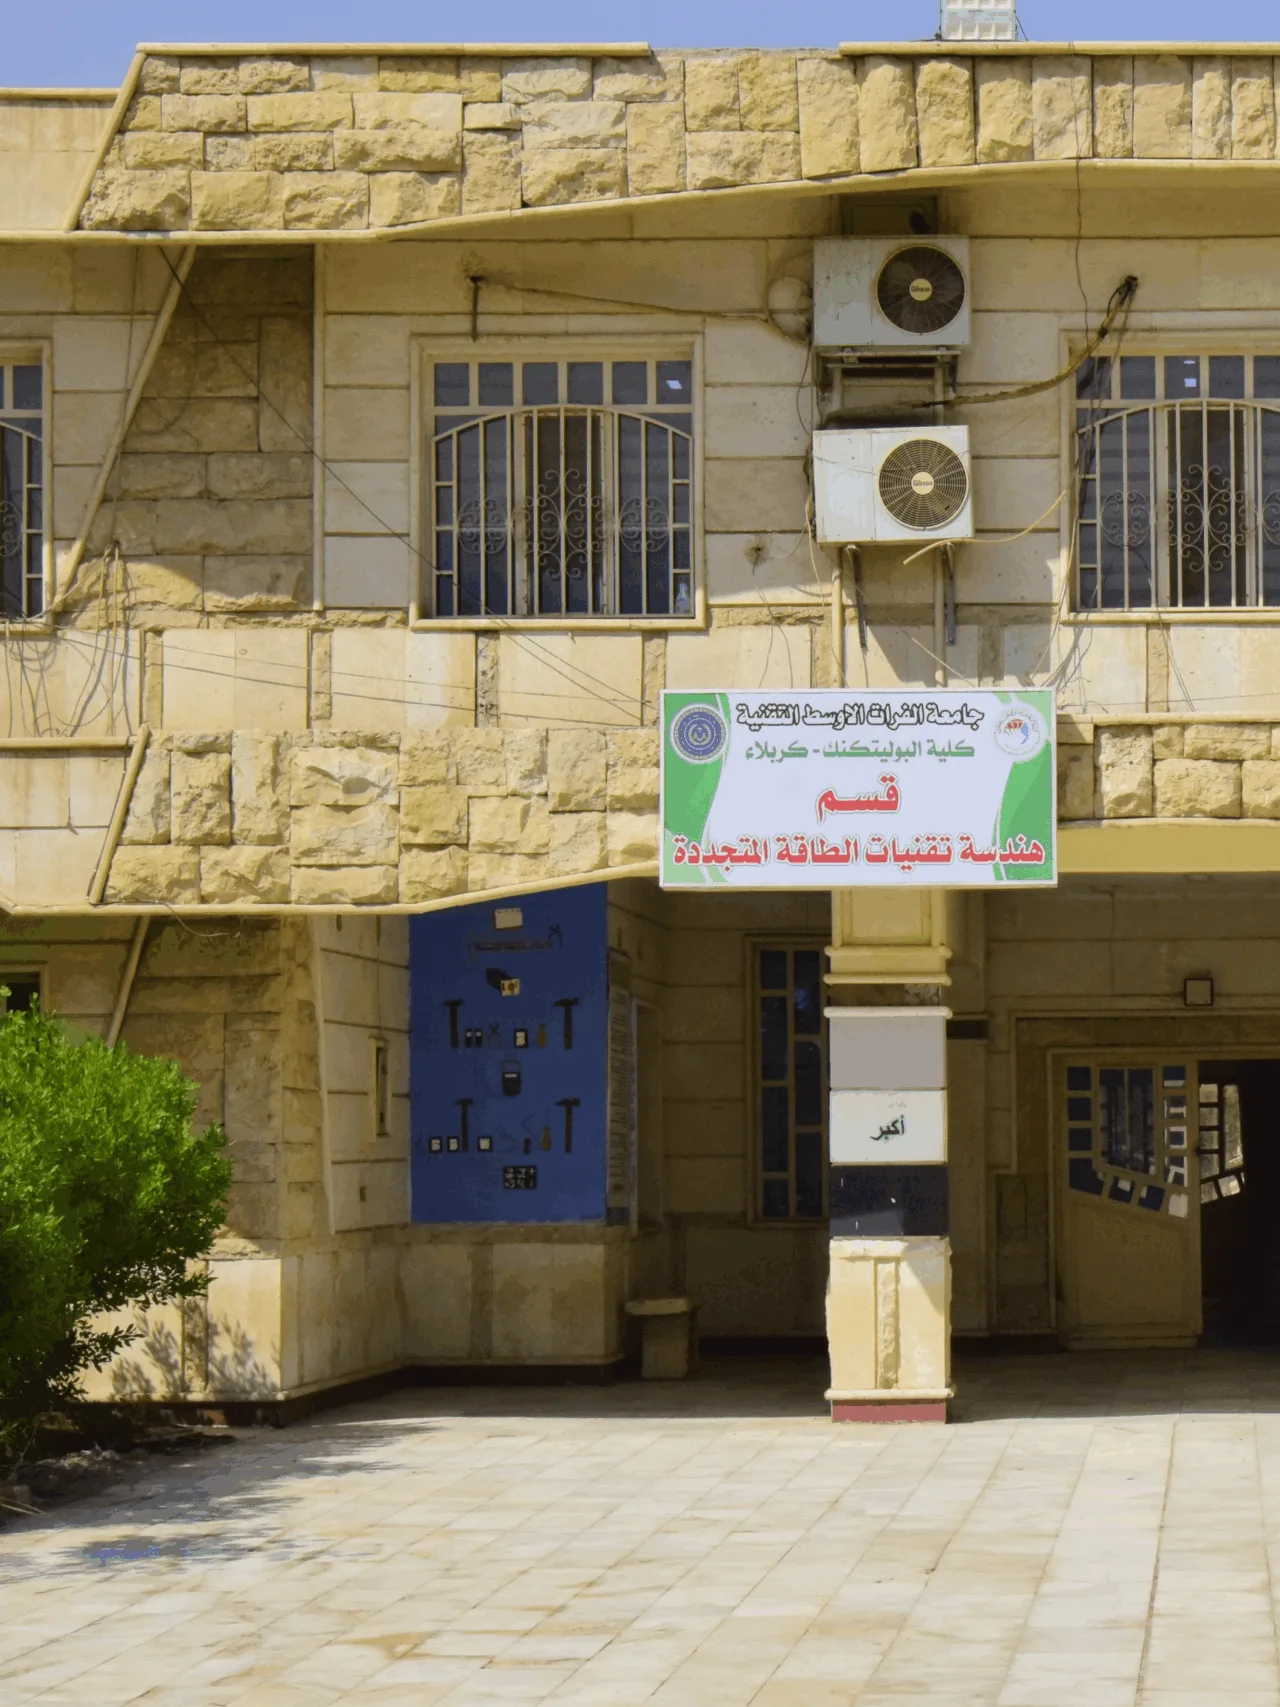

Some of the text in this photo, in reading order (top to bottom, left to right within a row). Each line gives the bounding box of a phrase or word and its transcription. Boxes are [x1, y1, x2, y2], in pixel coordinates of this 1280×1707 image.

[736, 702, 984, 731] جامعة الفرات الاوسط التقنية
[746, 740, 809, 763] كربلاء
[823, 740, 921, 763] البوليتكنك
[927, 739, 975, 762] كلية
[817, 774, 900, 822] قسم
[673, 835, 1044, 871] هندسة تقنيات الطاقة المتجددة
